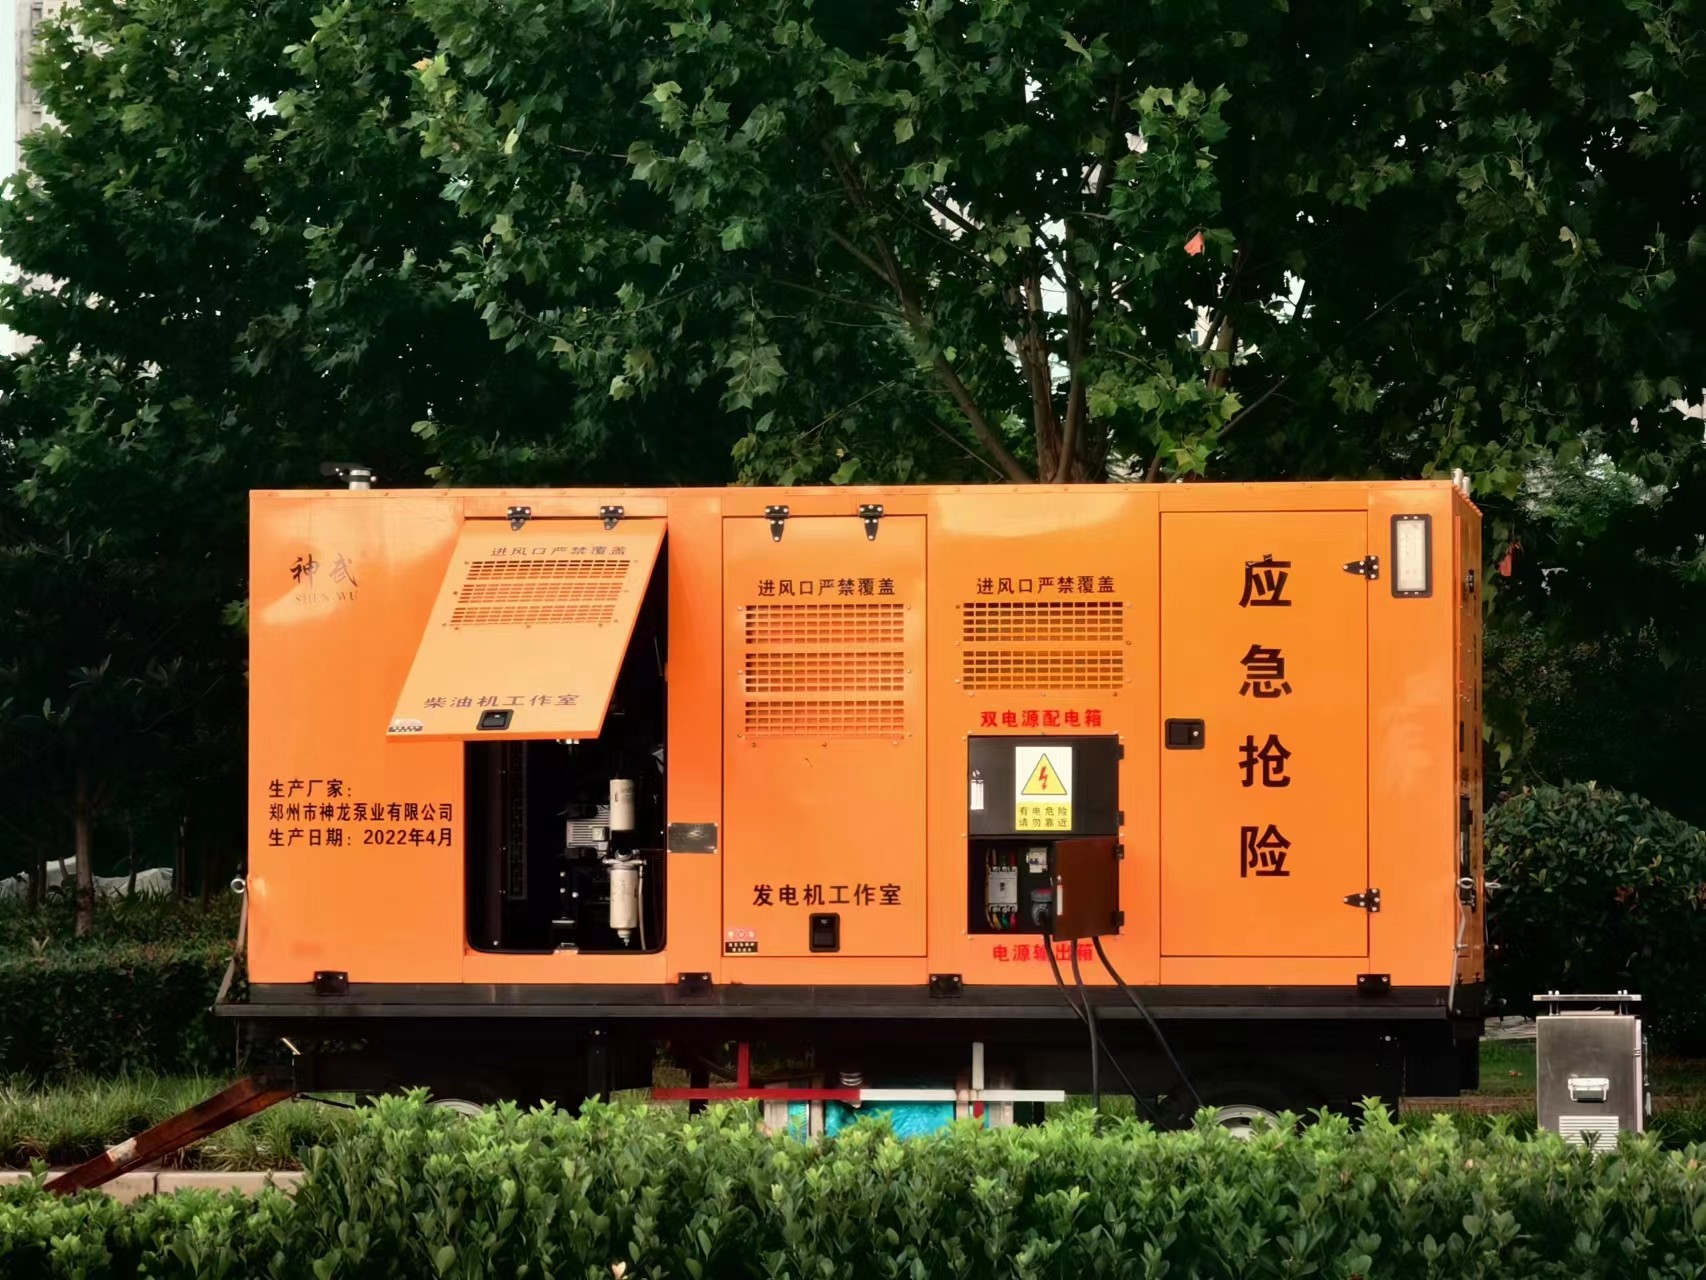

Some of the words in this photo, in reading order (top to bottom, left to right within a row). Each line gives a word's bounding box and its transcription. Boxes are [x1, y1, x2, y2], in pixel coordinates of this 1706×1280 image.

[490, 546, 628, 557] 进风口严禁覆盖
[758, 577, 895, 597] 进风口严禁覆盖
[976, 575, 1116, 595] 进风口严禁覆盖
[423, 693, 580, 710] 柴油机工作室
[980, 709, 1103, 728] 双电源配电箱
[1238, 554, 1292, 878] 应急抢险
[268, 778, 352, 798] 生产厂家：
[268, 802, 453, 822] 郑州市神龙泵业有限公司
[1019, 806, 1068, 817] 有电危险
[1018, 817, 1068, 828] 请勿靠近
[752, 883, 902, 907] 发电机工作室
